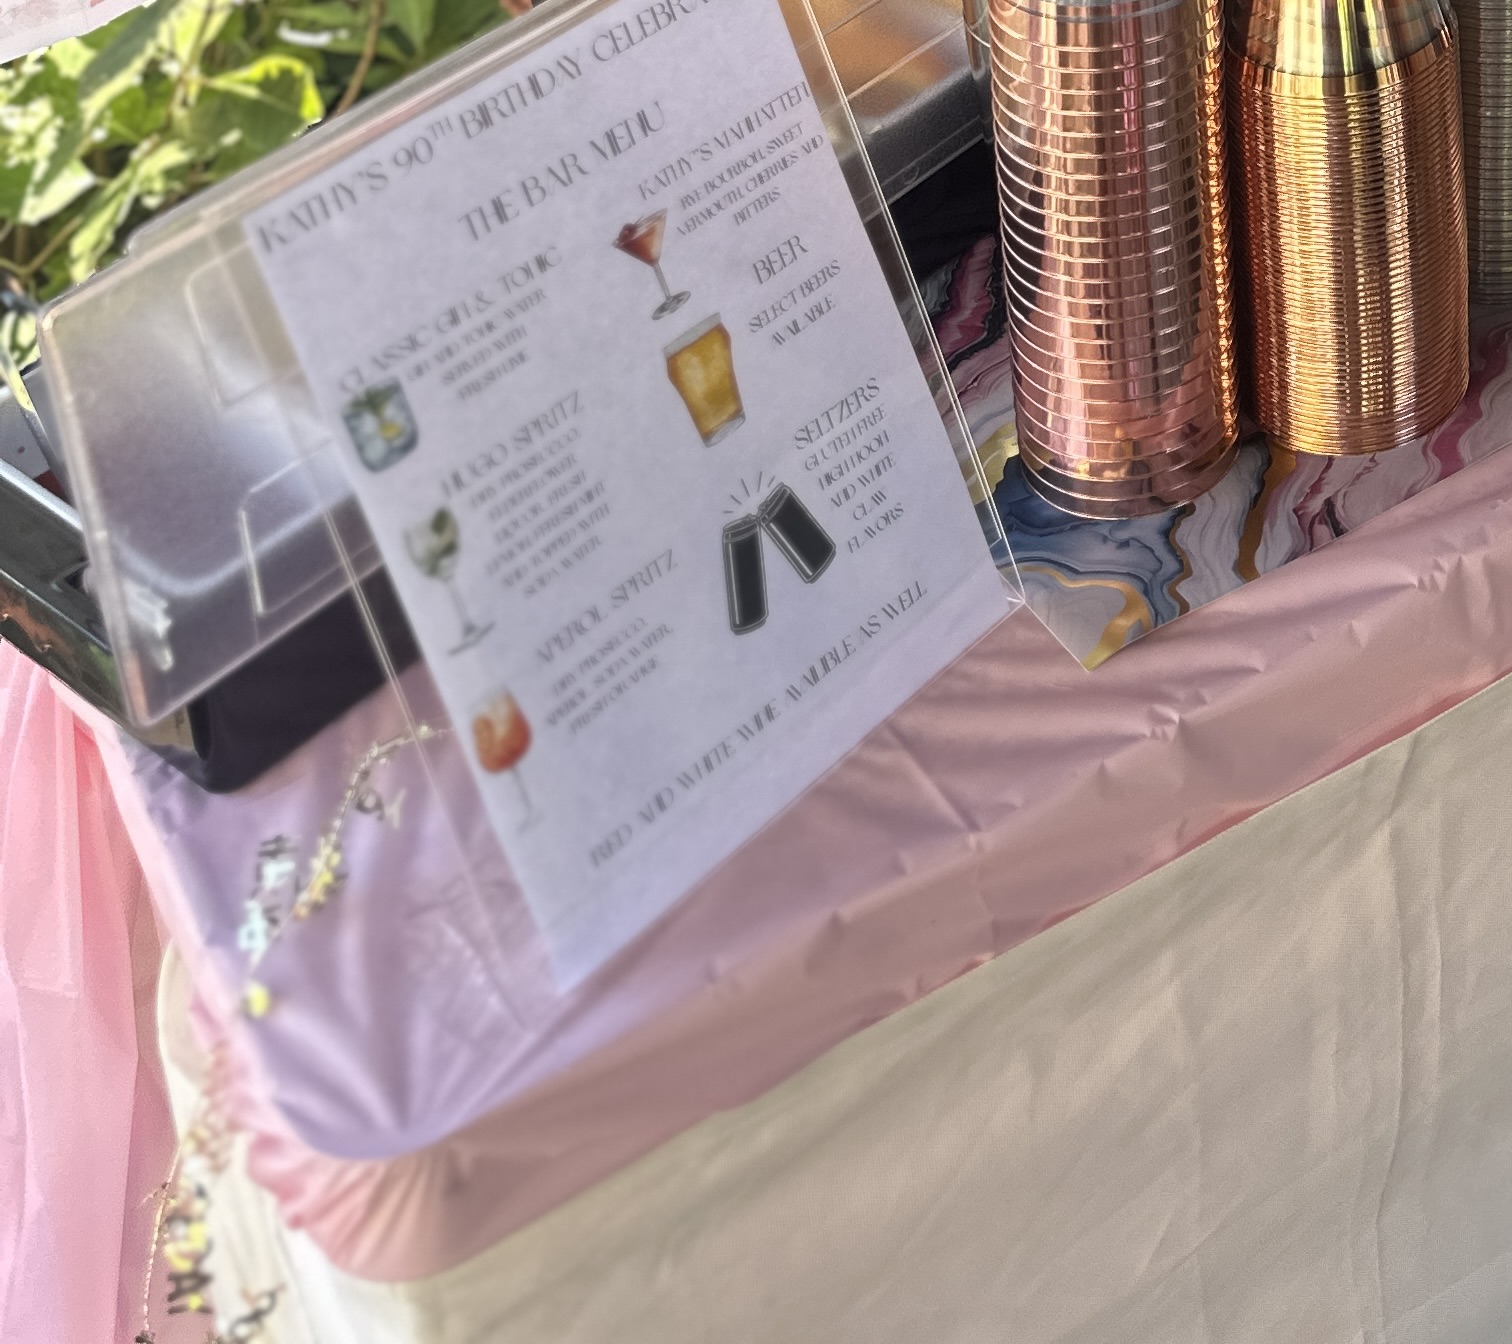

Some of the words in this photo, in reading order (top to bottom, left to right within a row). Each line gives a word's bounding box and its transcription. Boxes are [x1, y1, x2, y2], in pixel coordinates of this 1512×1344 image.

[257, 162, 389, 254] KATHY'S
[459, 47, 584, 140] BIRTHDAY
[458, 188, 520, 242] THE
[520, 152, 590, 208] BAR
[589, 101, 667, 162] MENU
[767, 121, 804, 156] SWEET
[800, 133, 824, 157] AND
[732, 186, 782, 227] BITTERS
[752, 234, 810, 286] BEER
[338, 324, 433, 395] CLASSIC
[496, 244, 563, 295] TONIC
[748, 290, 798, 333] SELECT
[799, 259, 842, 300] BEERS
[440, 442, 510, 498] HUGO
[512, 389, 586, 450] SPRITZ
[794, 376, 880, 450] SELTZERS
[804, 426, 858, 472] GLUTEN
[857, 402, 888, 436] FREE
[829, 483, 857, 509] AND
[857, 451, 898, 488] WHITE
[852, 485, 888, 521] CLAW
[846, 502, 906, 554] FLAVORS
[610, 547, 679, 609] SPRITZ
[589, 822, 634, 869] RED
[637, 785, 676, 826] AND
[675, 735, 737, 792] WHITE
[736, 697, 782, 743] WINE
[856, 614, 883, 644] AS
[881, 579, 929, 620] WELL
